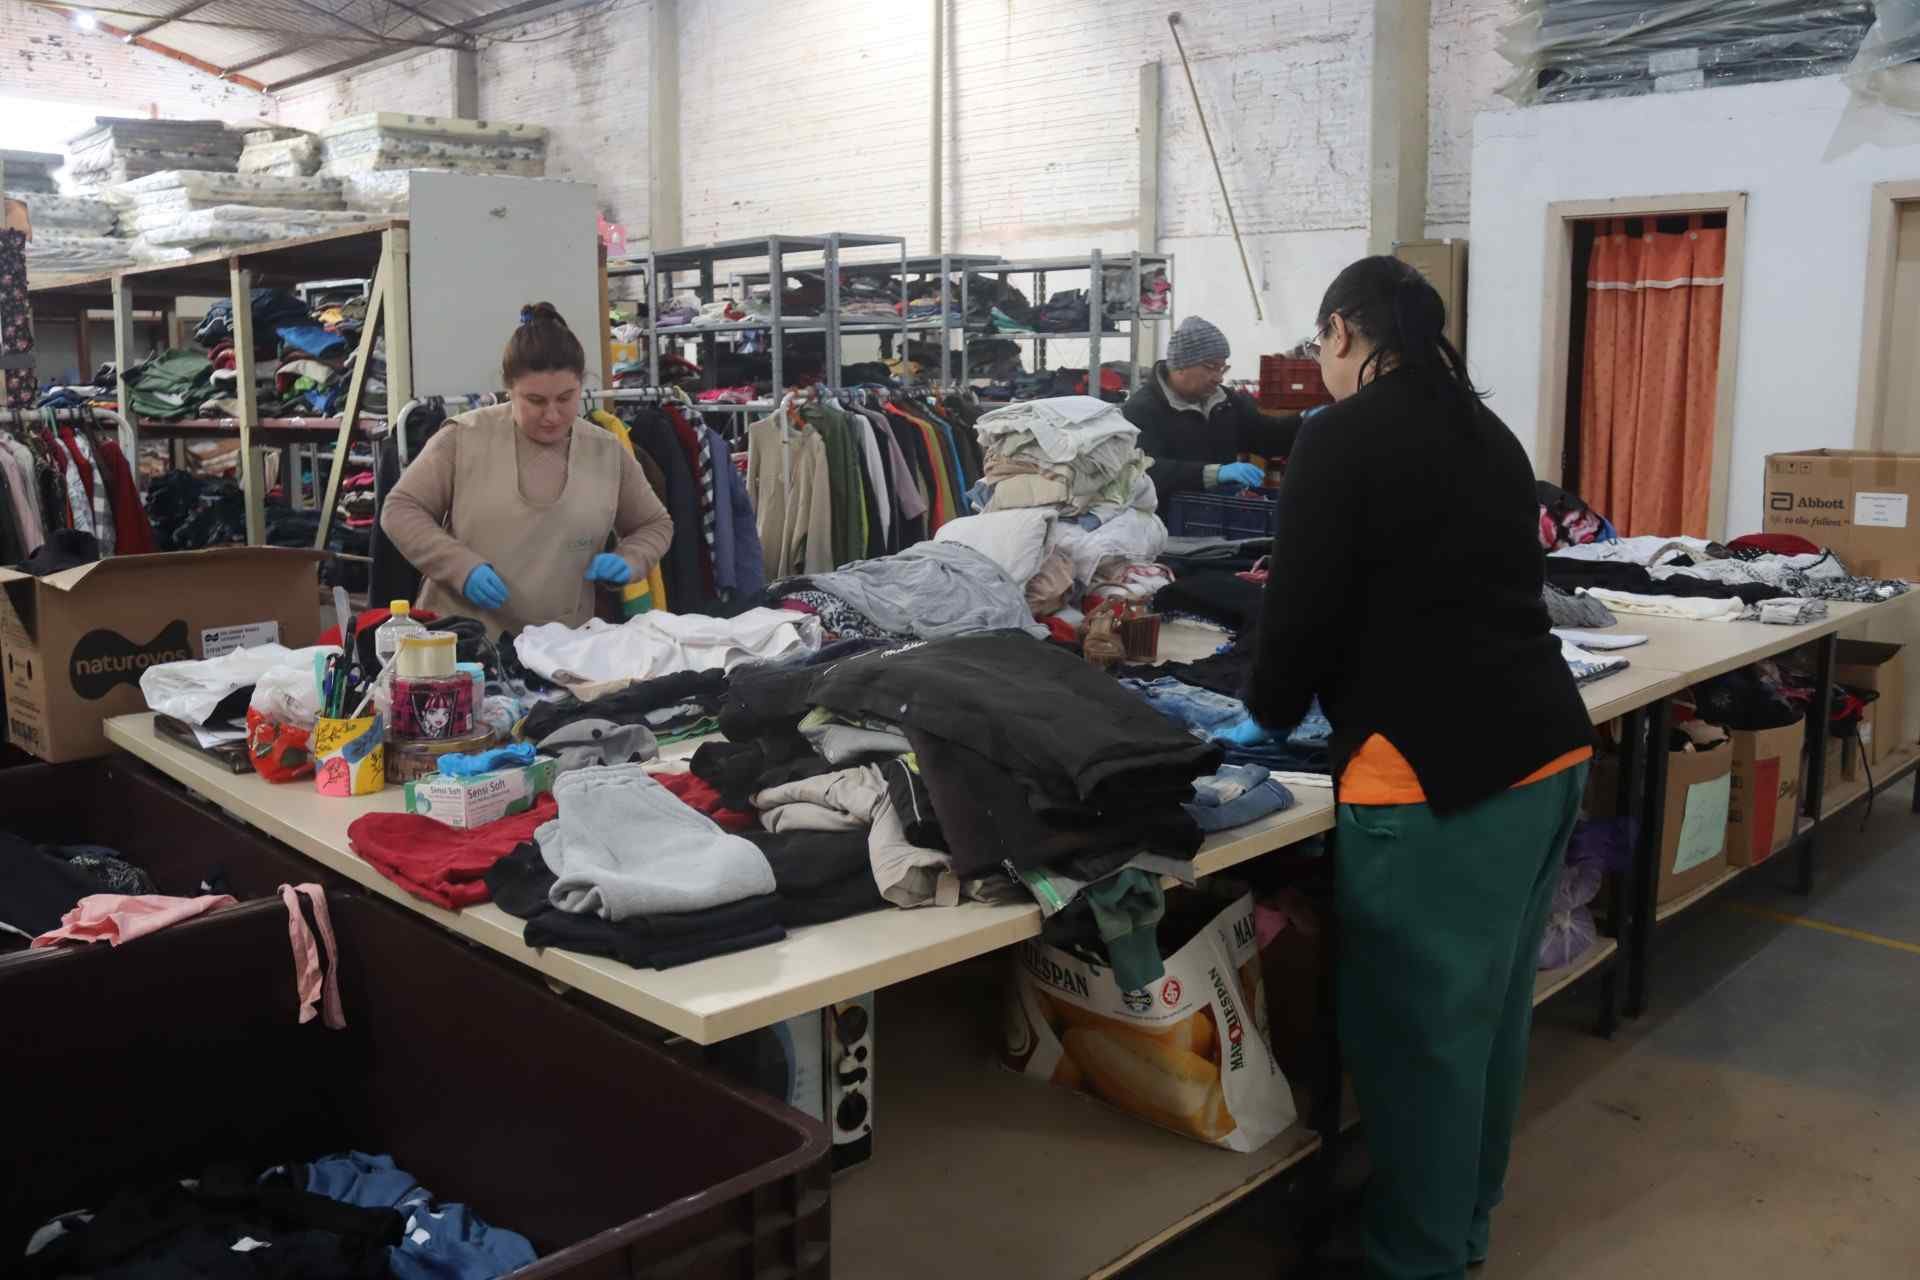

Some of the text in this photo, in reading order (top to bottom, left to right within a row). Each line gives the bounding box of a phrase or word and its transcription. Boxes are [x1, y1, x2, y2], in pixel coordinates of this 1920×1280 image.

[1797, 496, 1845, 509] Abbott
[1784, 516, 1794, 525] to
[1795, 515, 1809, 525] the
[1207, 966, 1245, 1072] MARQUESPAN
